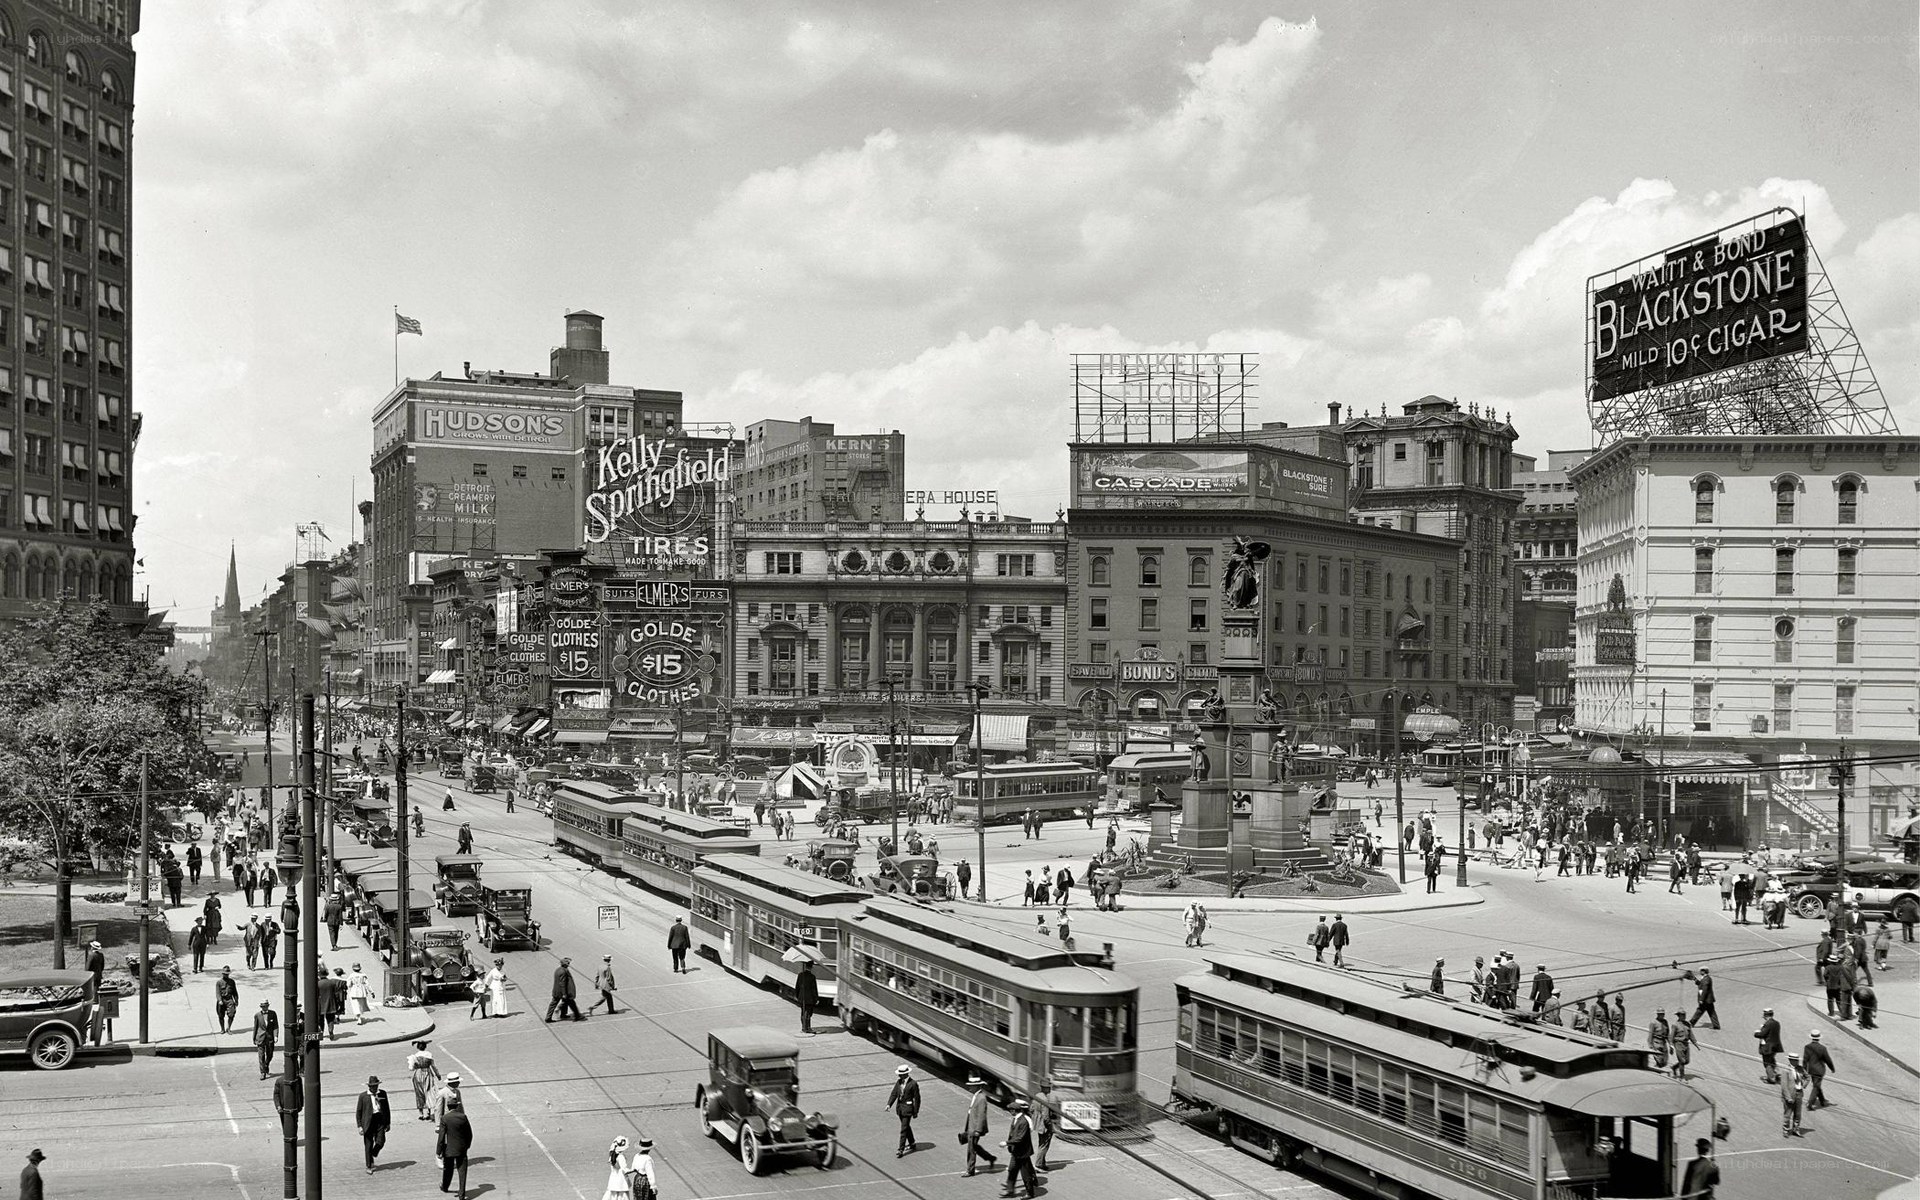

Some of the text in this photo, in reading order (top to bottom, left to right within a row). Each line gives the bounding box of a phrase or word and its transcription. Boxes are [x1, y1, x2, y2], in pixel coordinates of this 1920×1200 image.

[1631, 228, 1766, 292] WAITT & BOND
[1595, 249, 1795, 360] BLACKSTONE
[1622, 347, 1658, 370] MILD
[1707, 309, 1801, 355] CIGAR
[1100, 353, 1225, 375] HENKEL'S
[1123, 382, 1212, 404] FLOUR
[1658, 397, 1676, 410] LEE
[1689, 385, 1720, 402] CADY
[425, 409, 564, 438] HUDSON'S
[826, 438, 890, 450] KERN'S
[1094, 478, 1212, 488] CASCADE
[1283, 468, 1328, 484] BLACKSTONE
[454, 484, 490, 492] DETROIT
[584, 447, 730, 543] Springfield
[1309, 482, 1328, 492] SURE
[448, 493, 496, 502] CREAMERY
[944, 490, 997, 504] HOUSE
[454, 503, 489, 514] MILK
[458, 517, 496, 525] INSURANCE
[629, 536, 710, 555] TIRES
[550, 581, 590, 590] ELMER'S
[605, 582, 723, 606] SUITS ELMER'S FURS
[556, 619, 591, 628] GOLDE
[510, 634, 545, 645] GOLDE
[551, 632, 598, 648] CLOTHES
[630, 621, 696, 643] GOLDE
[510, 652, 546, 662] CLOTHES
[560, 651, 588, 672] $15
[642, 654, 682, 675] $15
[1123, 664, 1175, 680] BOND'S
[1188, 666, 1218, 678] CLOTH
[1298, 665, 1320, 680] BOND'S
[628, 681, 700, 706] CLOTHES
[1448, 1158, 1487, 1180] 7126
